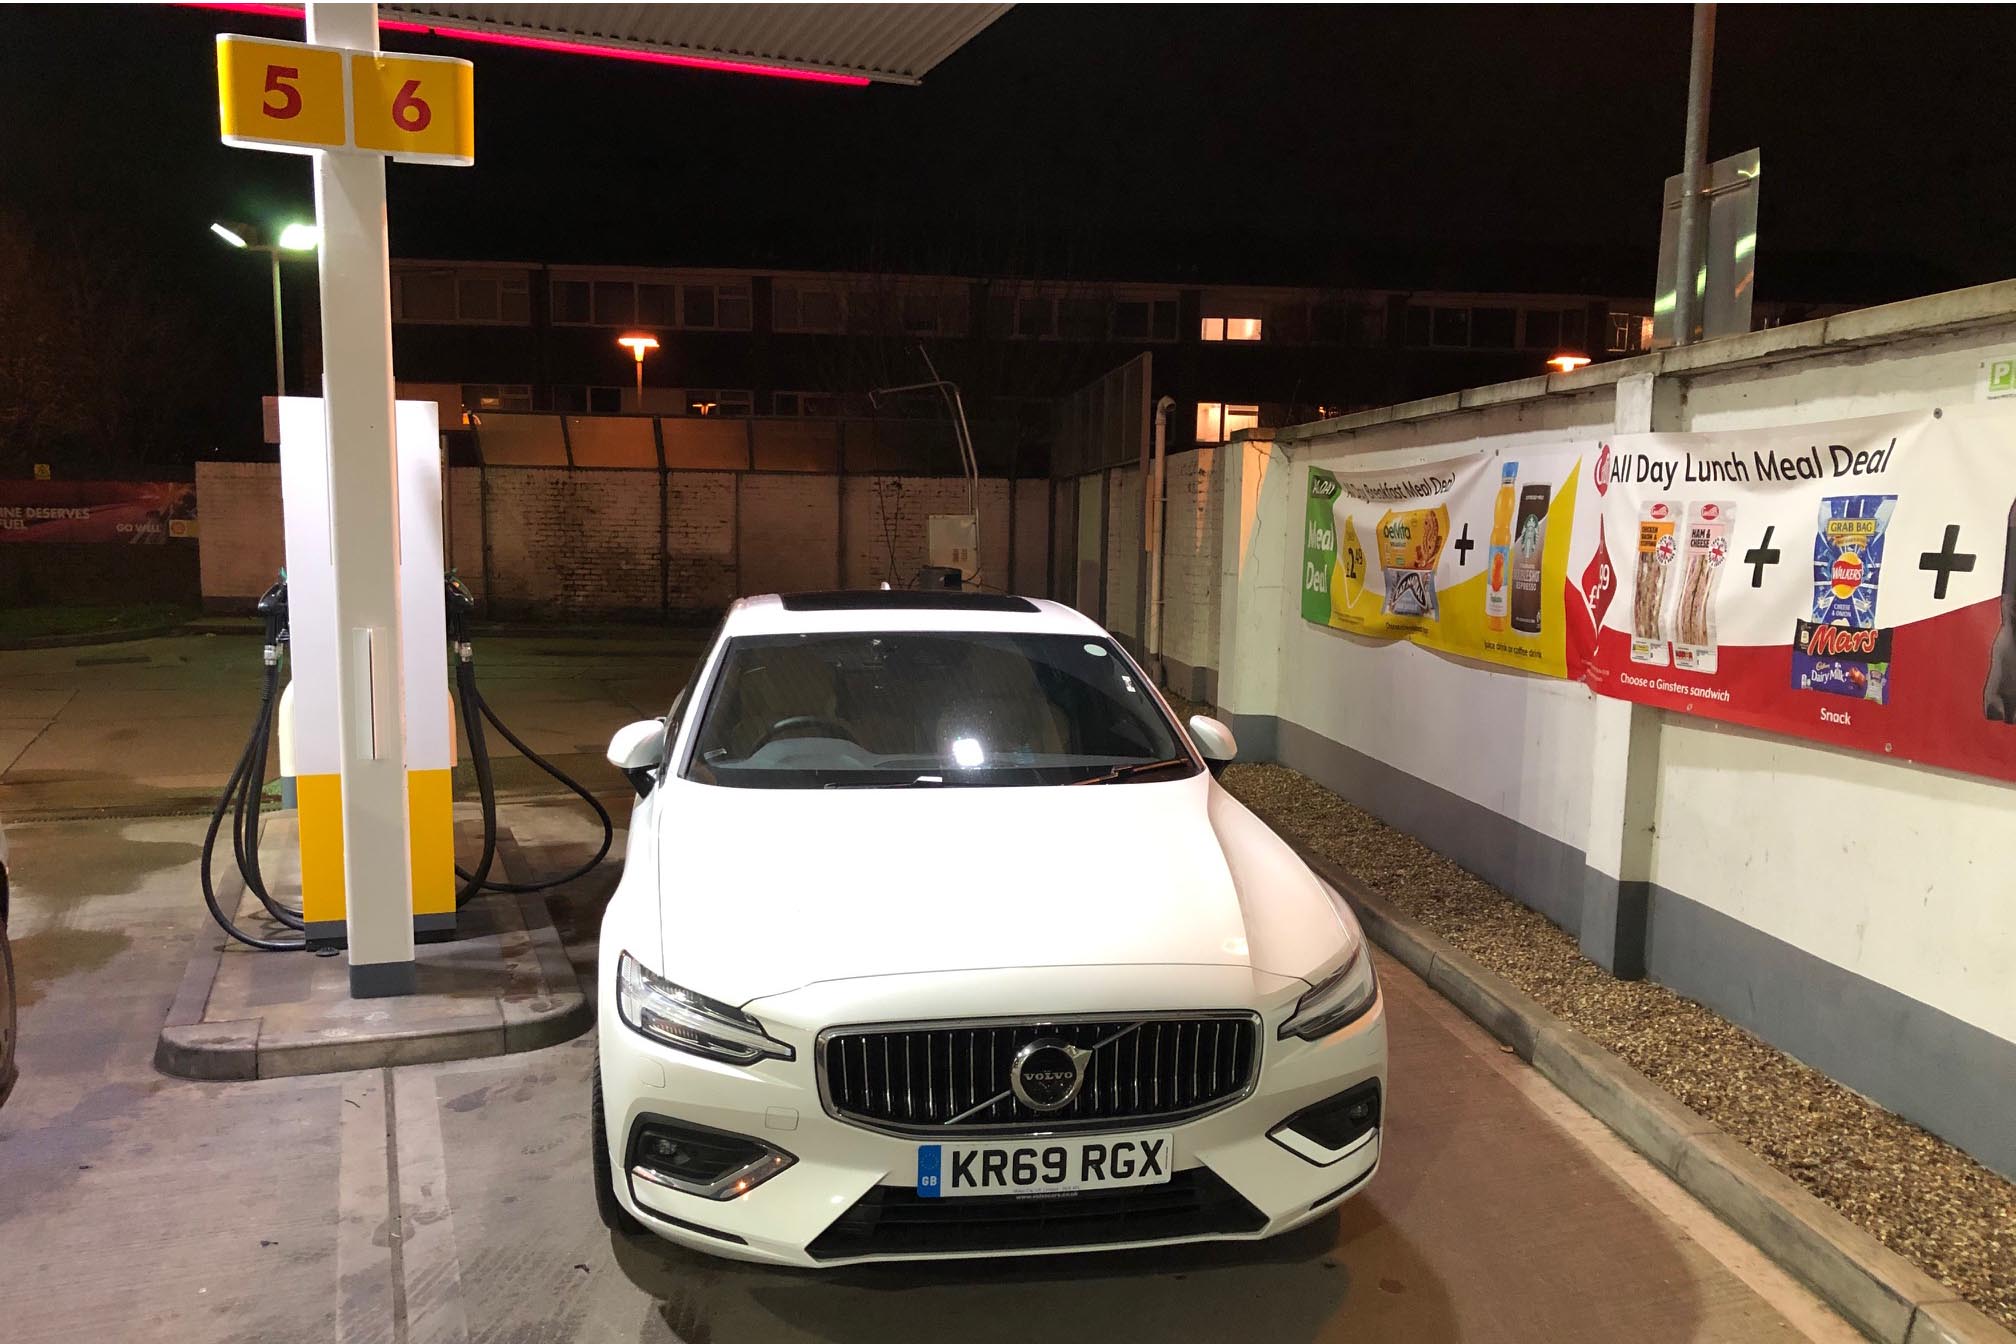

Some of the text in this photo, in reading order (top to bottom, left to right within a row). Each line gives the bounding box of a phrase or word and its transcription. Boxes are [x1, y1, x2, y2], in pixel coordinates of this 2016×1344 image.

[263, 65, 302, 119] 5
[392, 79, 431, 132] 6
[1610, 454, 1632, 483] All
[1636, 454, 1678, 491] Day
[1685, 451, 1749, 483] Lunch
[1754, 443, 1823, 482] Meal
[1829, 437, 1897, 477] Deal
[1406, 477, 1432, 499] Meal
[1430, 472, 1456, 495] Deal
[25, 507, 90, 519] DESERVES
[116, 523, 133, 532] GO
[1308, 520, 1334, 551] Meal
[1692, 529, 1705, 538] HAM
[1830, 522, 1873, 532] GRAB BAG
[1690, 539, 1710, 549] CHEESE
[1306, 561, 1328, 593] Deal
[1832, 566, 1861, 580] WALKERS
[1807, 624, 1878, 656] Mars
[1620, 672, 1730, 702] Choose a Ginsters sandwich
[1811, 669, 1830, 684] Dairy
[1820, 707, 1851, 725] Snack
[1023, 1070, 1073, 1081] VOLVO
[922, 1175, 937, 1187] GB
[951, 1146, 1068, 1188] KR69
[1081, 1139, 1164, 1181] RGX
